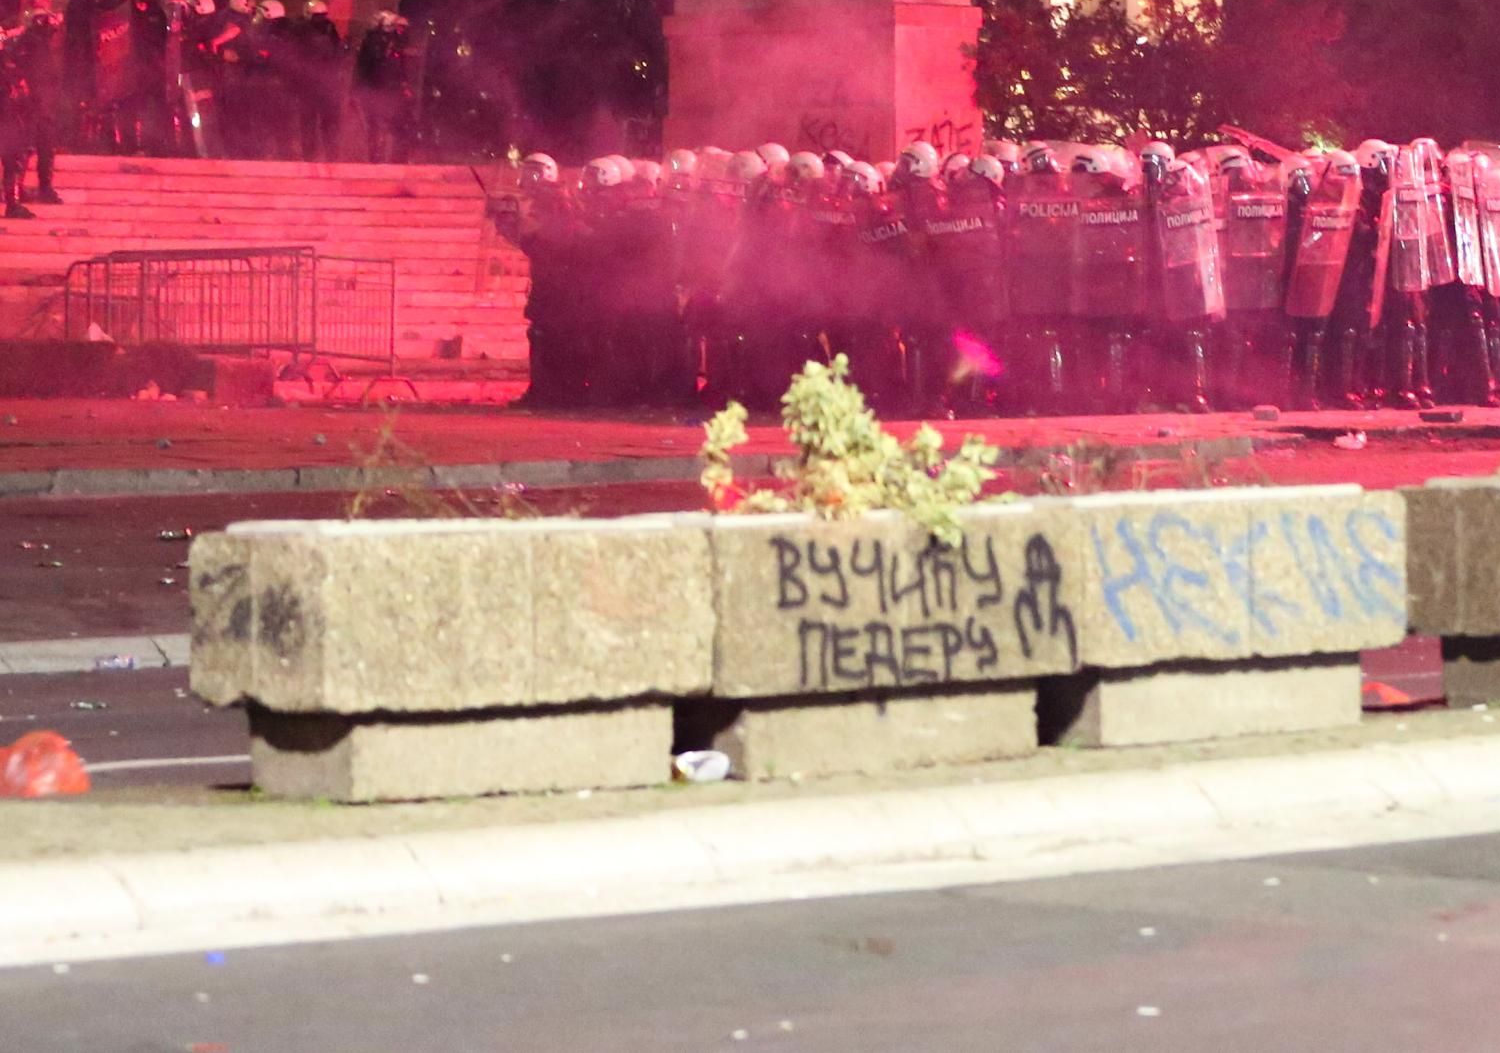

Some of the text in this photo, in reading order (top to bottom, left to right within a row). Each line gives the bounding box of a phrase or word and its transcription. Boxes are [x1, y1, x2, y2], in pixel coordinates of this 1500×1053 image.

[1019, 201, 1079, 218] POLICIJA
[857, 219, 908, 244] OLICIJA
[798, 615, 1000, 687] ПЕДЕРУ
